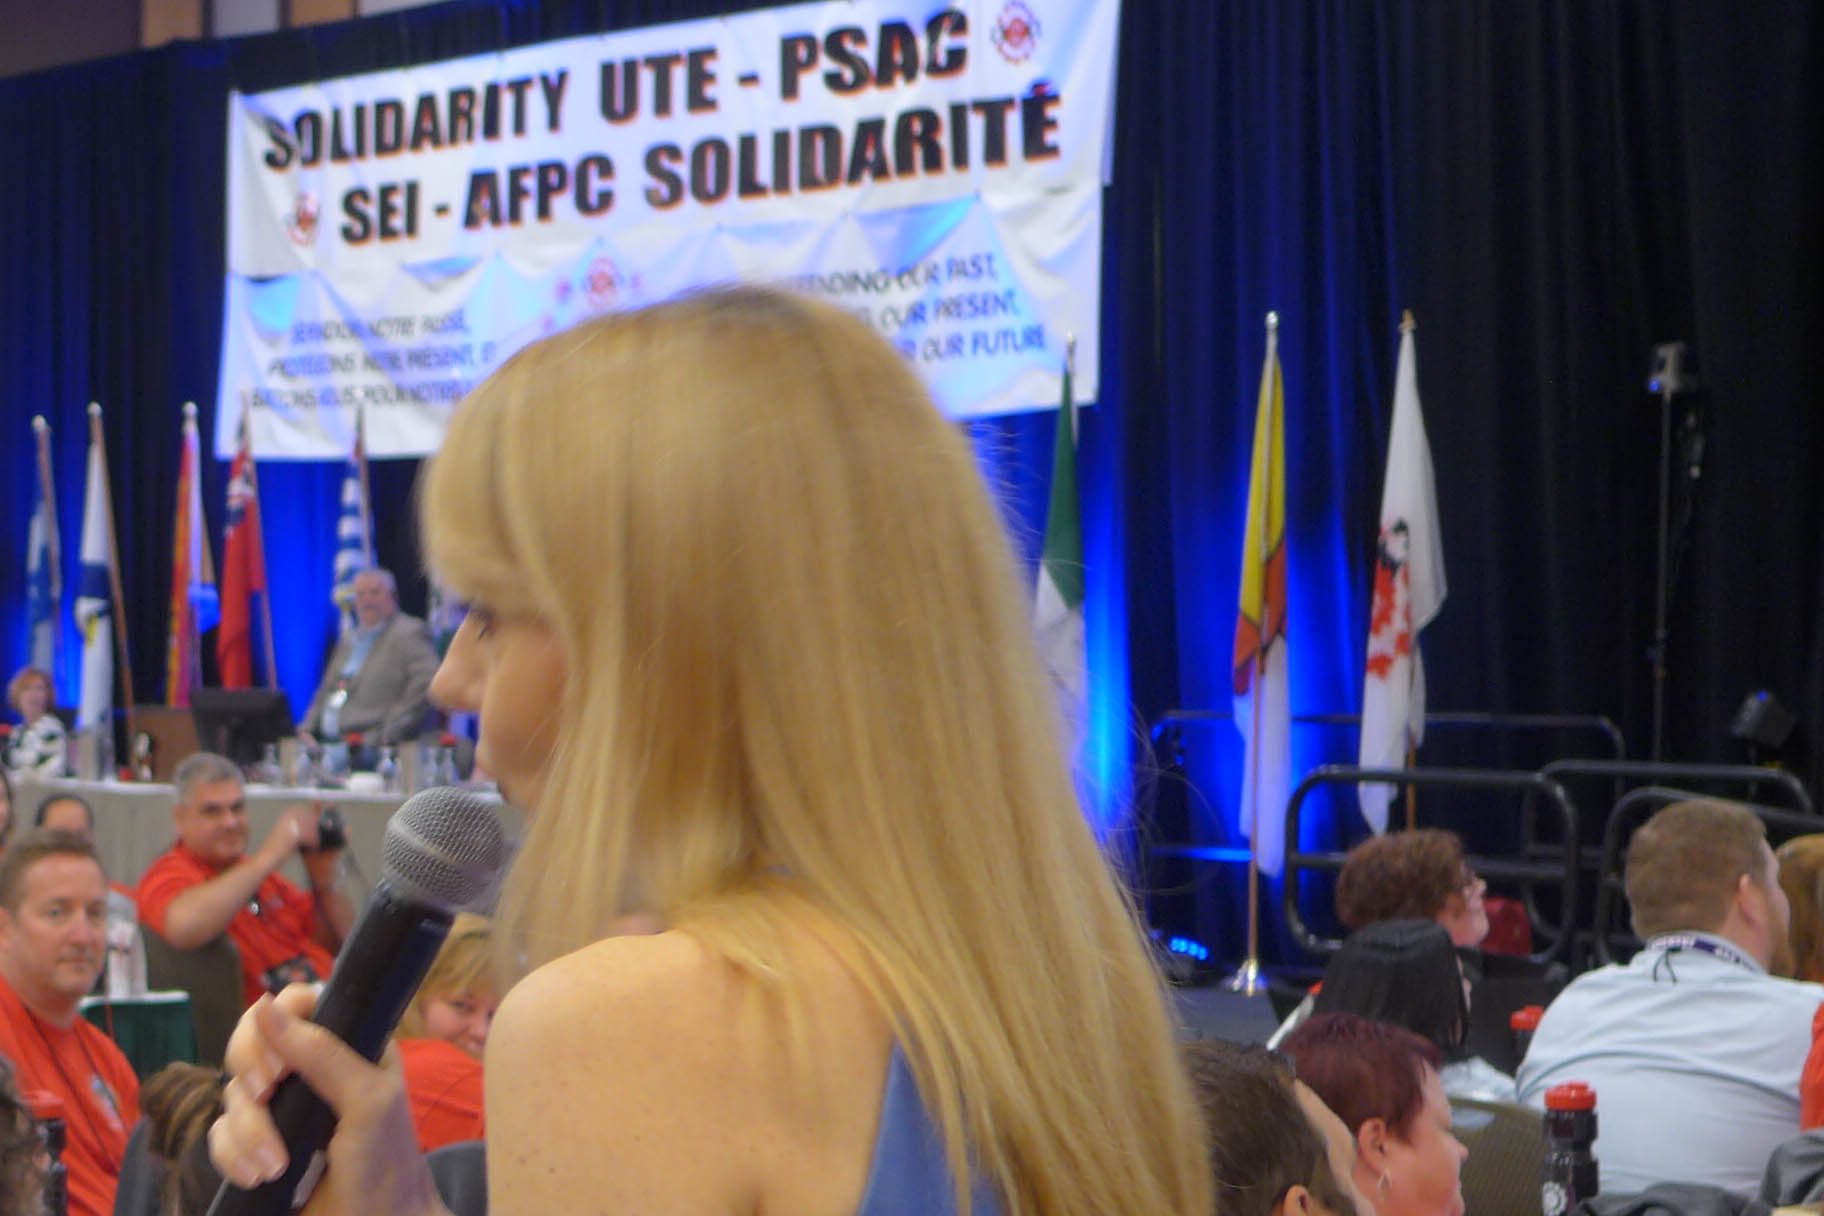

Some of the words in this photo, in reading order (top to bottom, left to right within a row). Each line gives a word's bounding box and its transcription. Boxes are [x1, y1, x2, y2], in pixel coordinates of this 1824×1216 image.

[263, 69, 569, 171] SOLIDARITY
[599, 46, 718, 125] UTE
[779, 7, 970, 101] PSAC
[341, 179, 421, 246] SEI
[463, 153, 615, 230] AFPC
[642, 79, 1063, 210] SOLIDARITÉ
